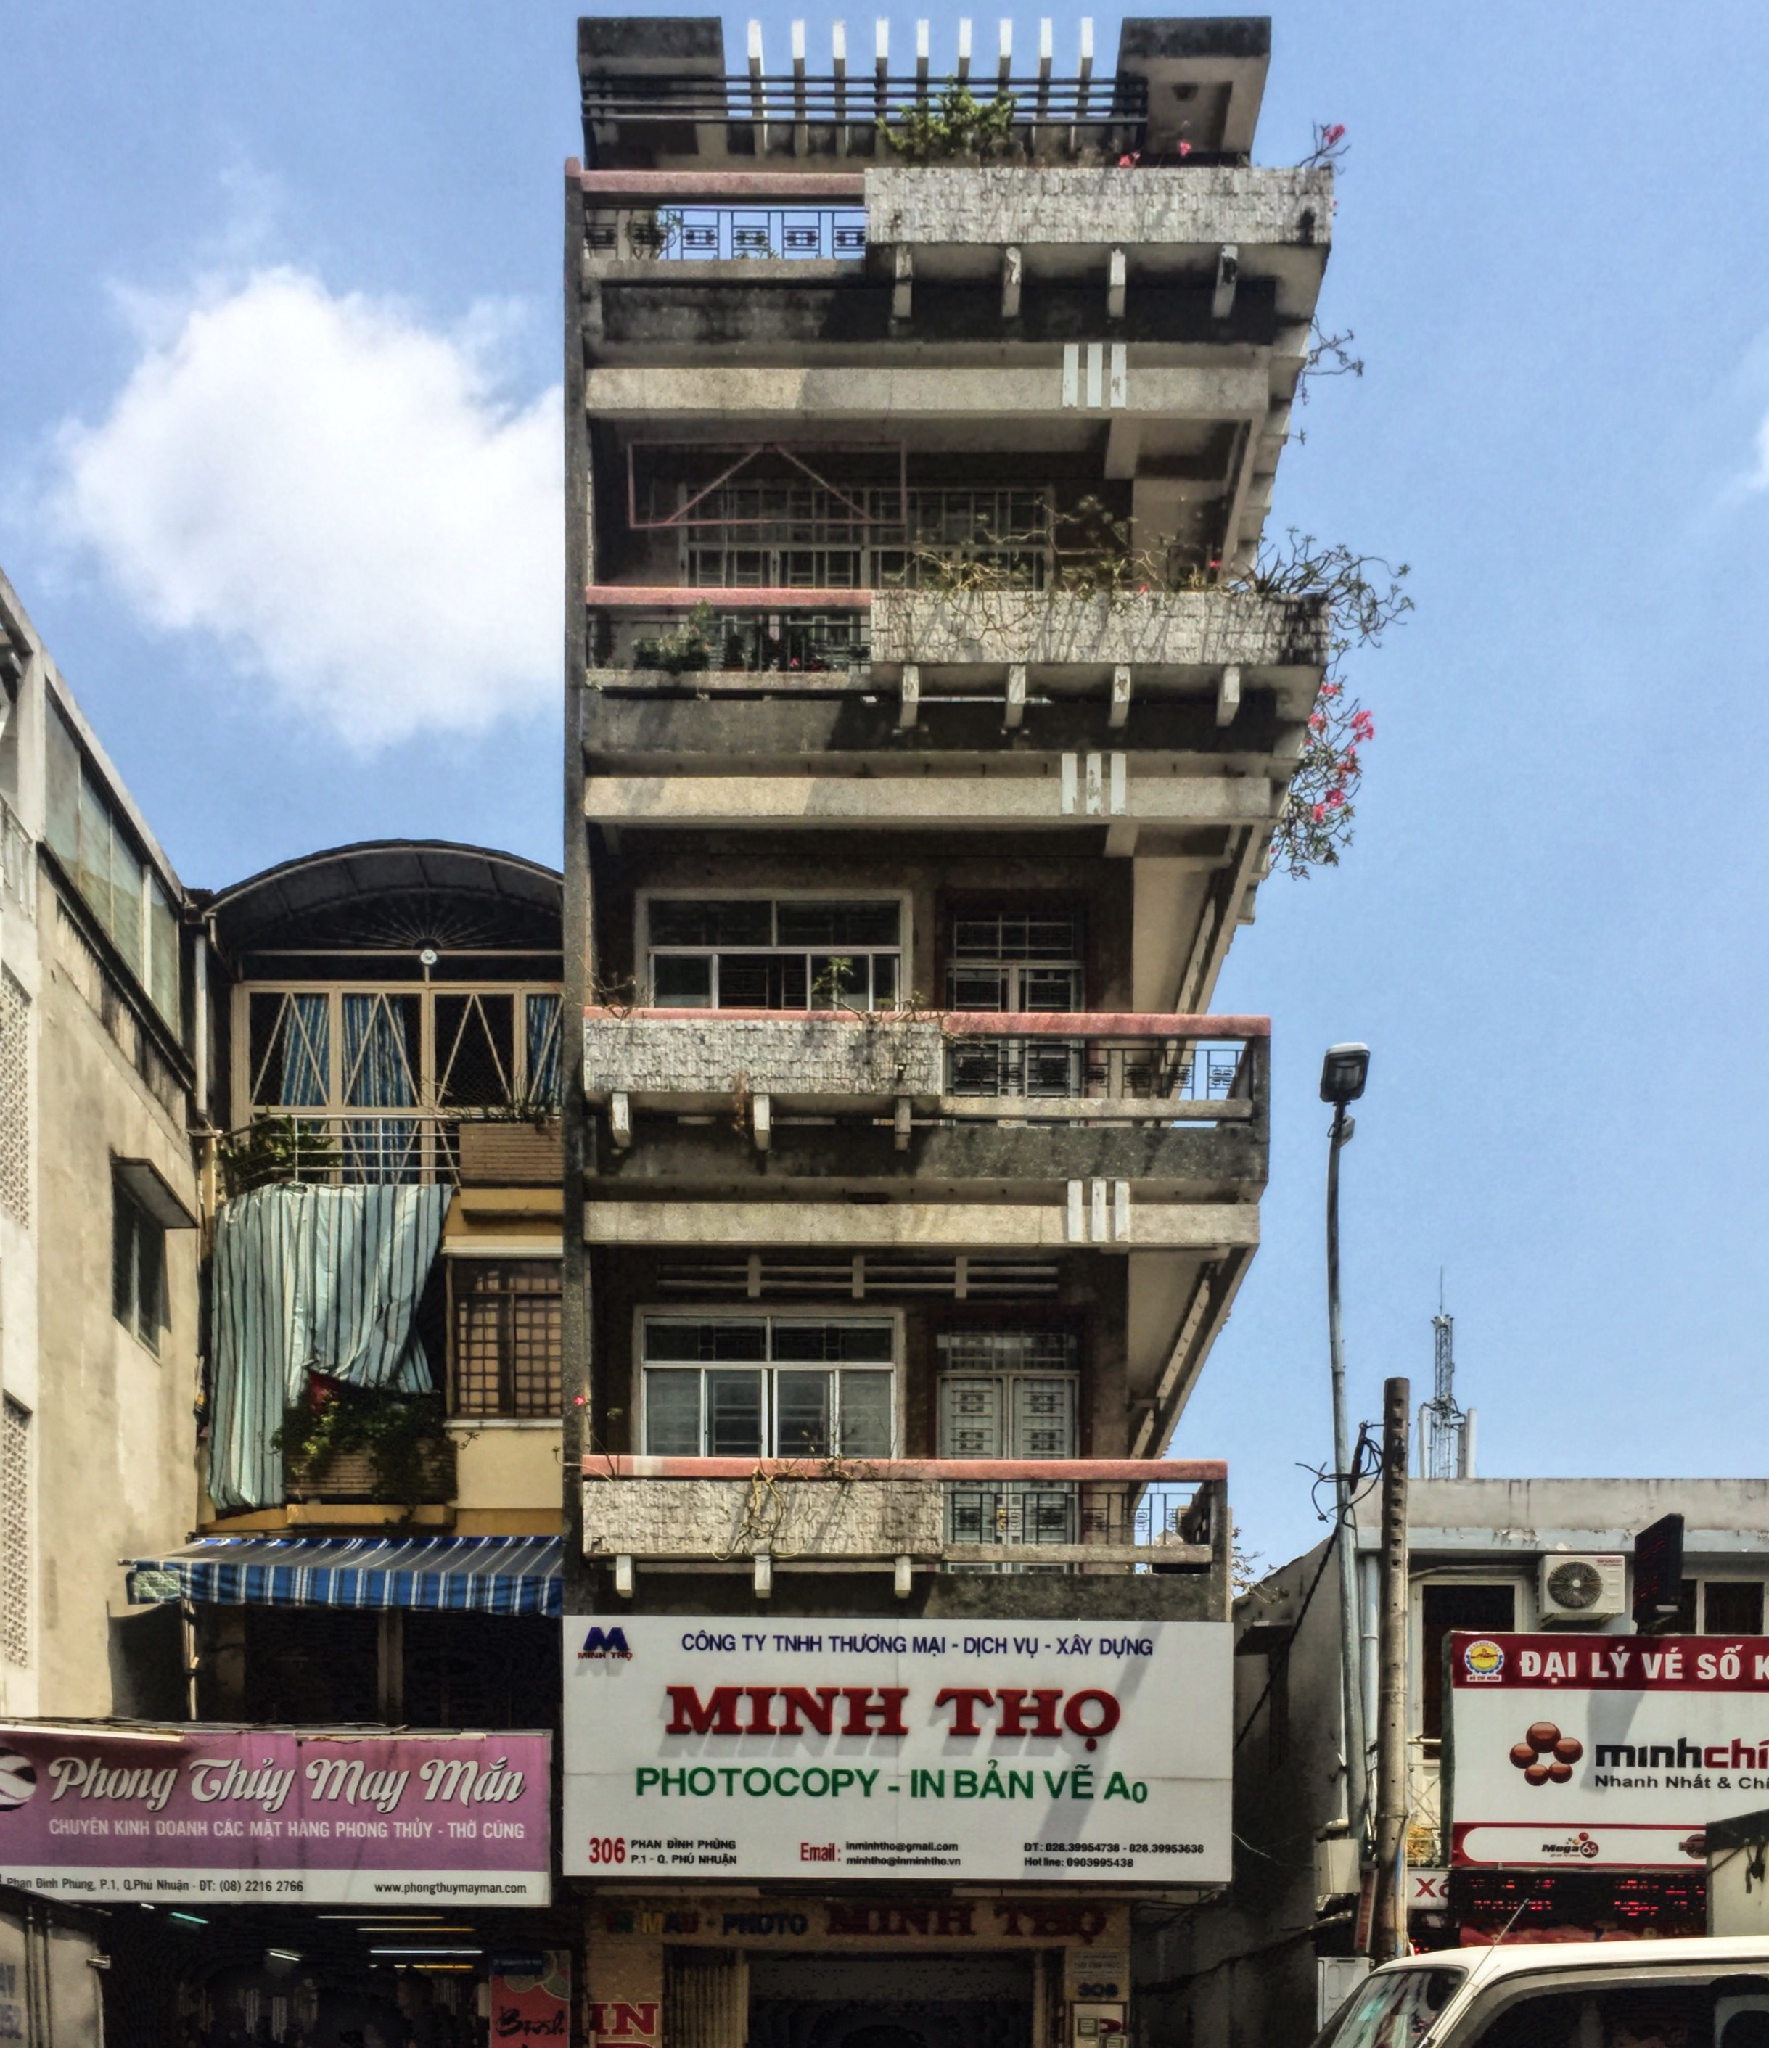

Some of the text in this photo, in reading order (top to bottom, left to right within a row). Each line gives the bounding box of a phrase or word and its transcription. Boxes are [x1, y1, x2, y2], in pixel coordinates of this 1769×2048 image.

[681, 1630, 736, 1651] CÔNG
[741, 1634, 767, 1651] TY
[772, 1635, 822, 1652] TNHH
[828, 1634, 907, 1653] THƯƠNG
[912, 1637, 946, 1656] MẠI
[963, 1637, 1007, 1657] DỊCH
[1013, 1637, 1038, 1658] VỤ
[1056, 1634, 1093, 1655] XÂY
[1099, 1637, 1153, 1659] DỰNG
[1518, 1651, 1576, 1683] ĐẠI
[1592, 1646, 1631, 1678] LÝ
[1642, 1646, 1684, 1679] VÉ
[1697, 1644, 1743, 1680] SỐ
[665, 1686, 1121, 1752] MINH THỌ
[48, 1756, 526, 1813] Phong Thủy May Mắn
[635, 1767, 878, 1799] PHOTOCOPY
[911, 1769, 945, 1798] IN
[954, 1759, 1034, 1799] BẢN
[1043, 1764, 1094, 1799] VẼ
[1595, 1774, 1658, 1789] Nhanh
[1665, 1773, 1711, 1789] Nhất
[1717, 1776, 1732, 1789] &
[49, 1817, 109, 1836] CHUYÊN
[114, 1819, 150, 1836] KINH
[156, 1819, 209, 1837] DOANH
[212, 1818, 243, 1837] CÁC
[249, 1817, 283, 1840] MẶT
[287, 1818, 330, 1838] HÀNG
[335, 1820, 388, 1839] PHONG
[393, 1817, 433, 1839] THỦY
[448, 1819, 477, 1839] THỜ
[482, 1820, 526, 1839] CÚNG
[588, 1837, 626, 1864] 306
[630, 1837, 737, 1850] PHAN ĐÌNH PHÙNG
[846, 1840, 959, 1853] inminhtho@gmail.com
[1045, 1842, 1121, 1853] 028.39954738
[1541, 1843, 1580, 1854] Mega
[630, 1854, 646, 1864] P.1
[672, 1852, 695, 1864] PHÚ
[698, 1852, 738, 1867] NHUẬN
[846, 1855, 962, 1867] minhtho@inminhtho.vn
[1066, 1857, 1134, 1868] 0903995438
[99, 1878, 119, 1891] P.1,
[156, 1878, 190, 1893] Nhuận
[218, 1879, 241, 1893] (08)
[245, 1880, 272, 1892] 2216
[275, 1880, 303, 1892] 2766
[373, 1882, 527, 1895] www.phongthuymayman.com
[722, 1911, 809, 1936] PHOTO
[823, 1904, 976, 1937] MINH
[587, 2002, 661, 2037] IN
